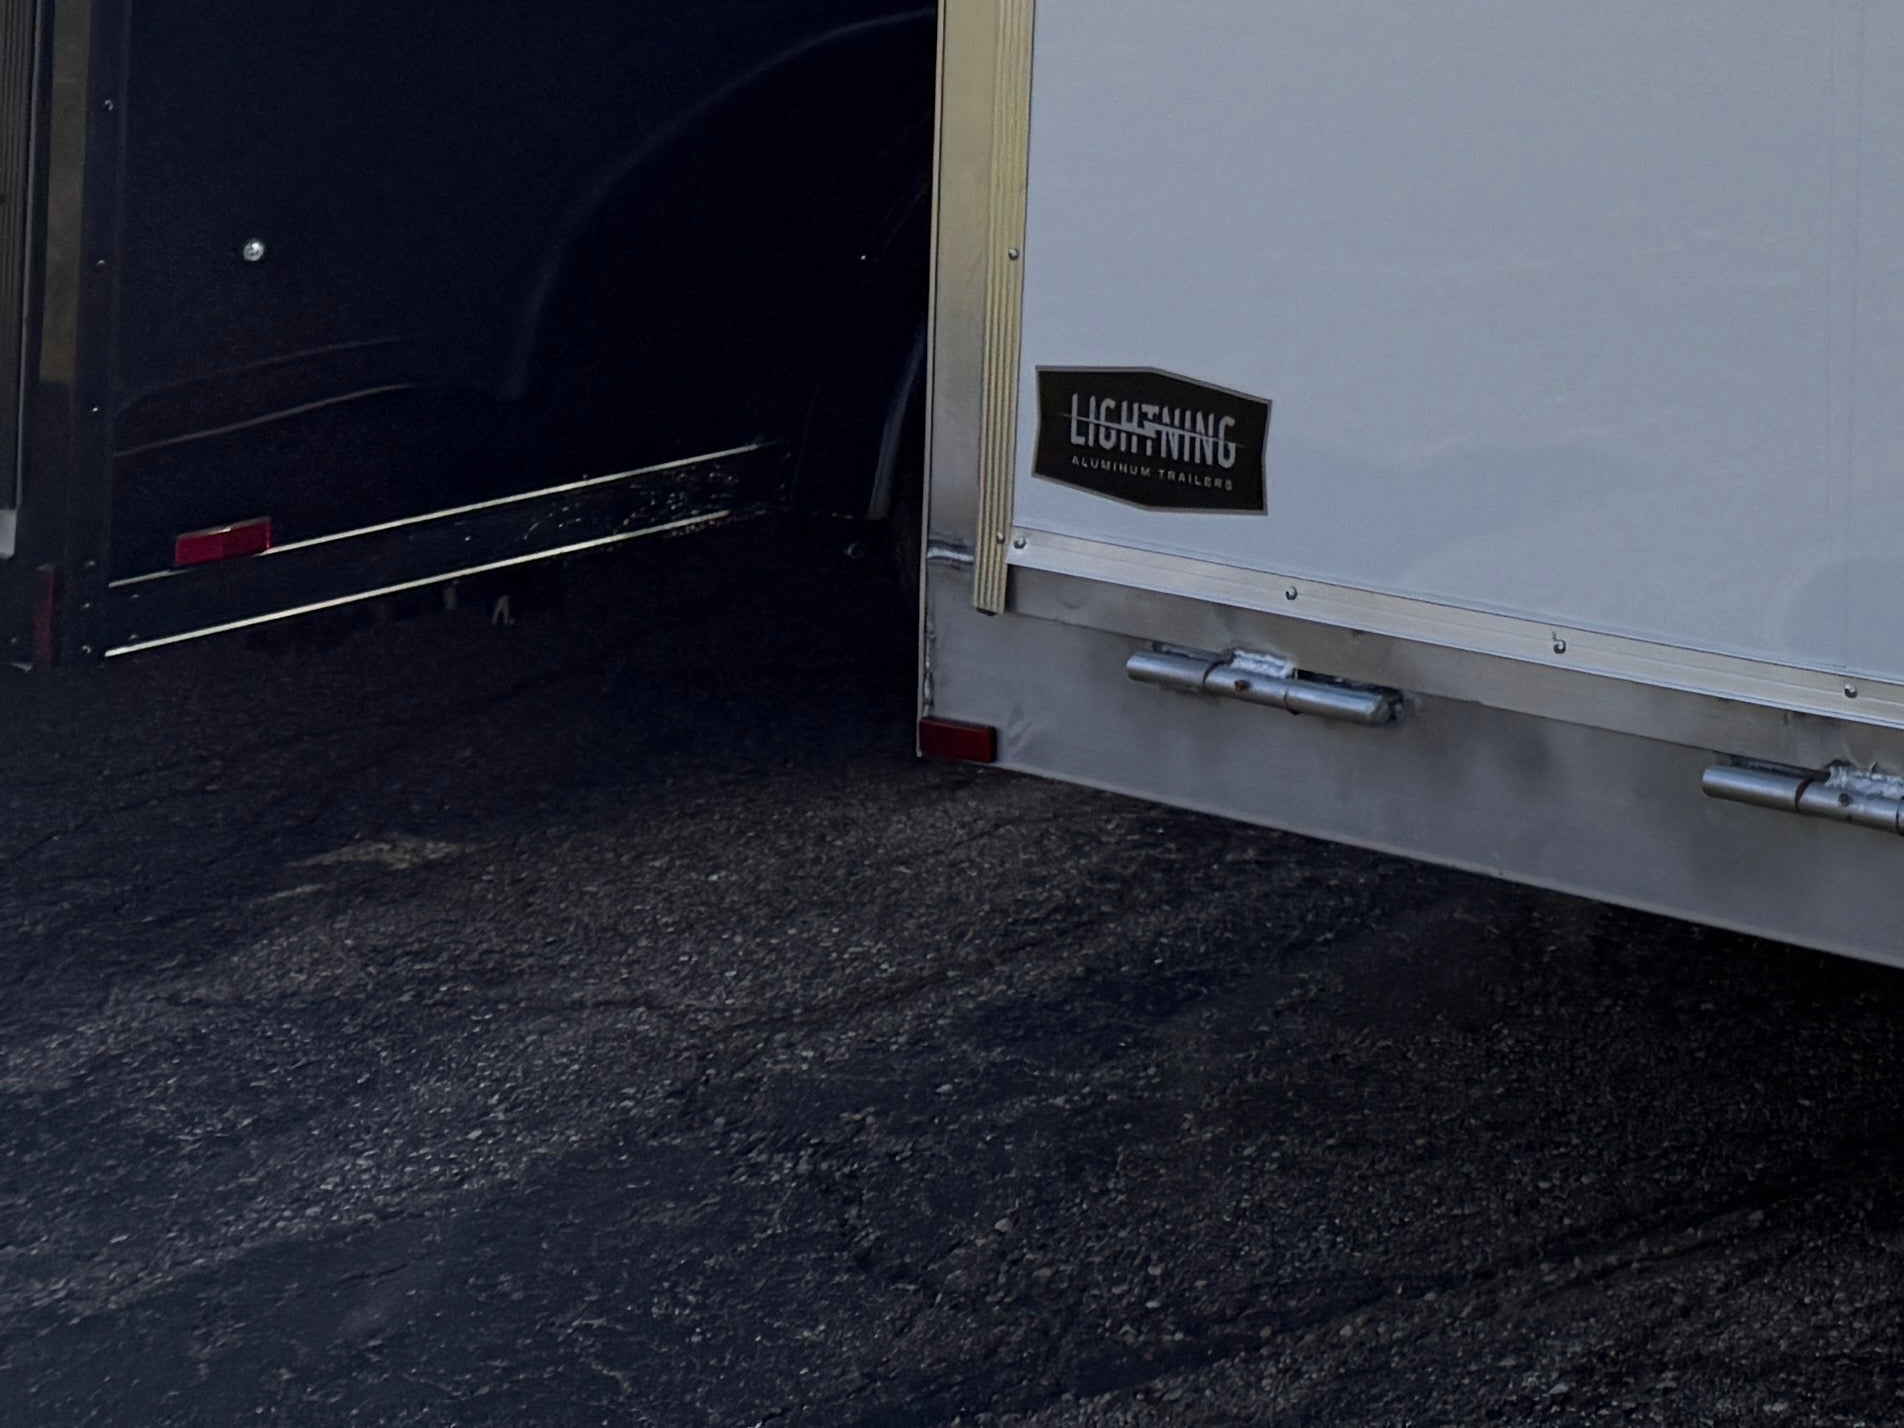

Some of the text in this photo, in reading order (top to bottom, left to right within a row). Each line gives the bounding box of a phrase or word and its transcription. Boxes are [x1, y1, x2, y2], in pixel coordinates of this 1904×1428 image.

[1069, 393, 1237, 469] LIGHTNING
[1071, 455, 1151, 477] ALUMINUM
[1157, 468, 1233, 491] TRAILERS
